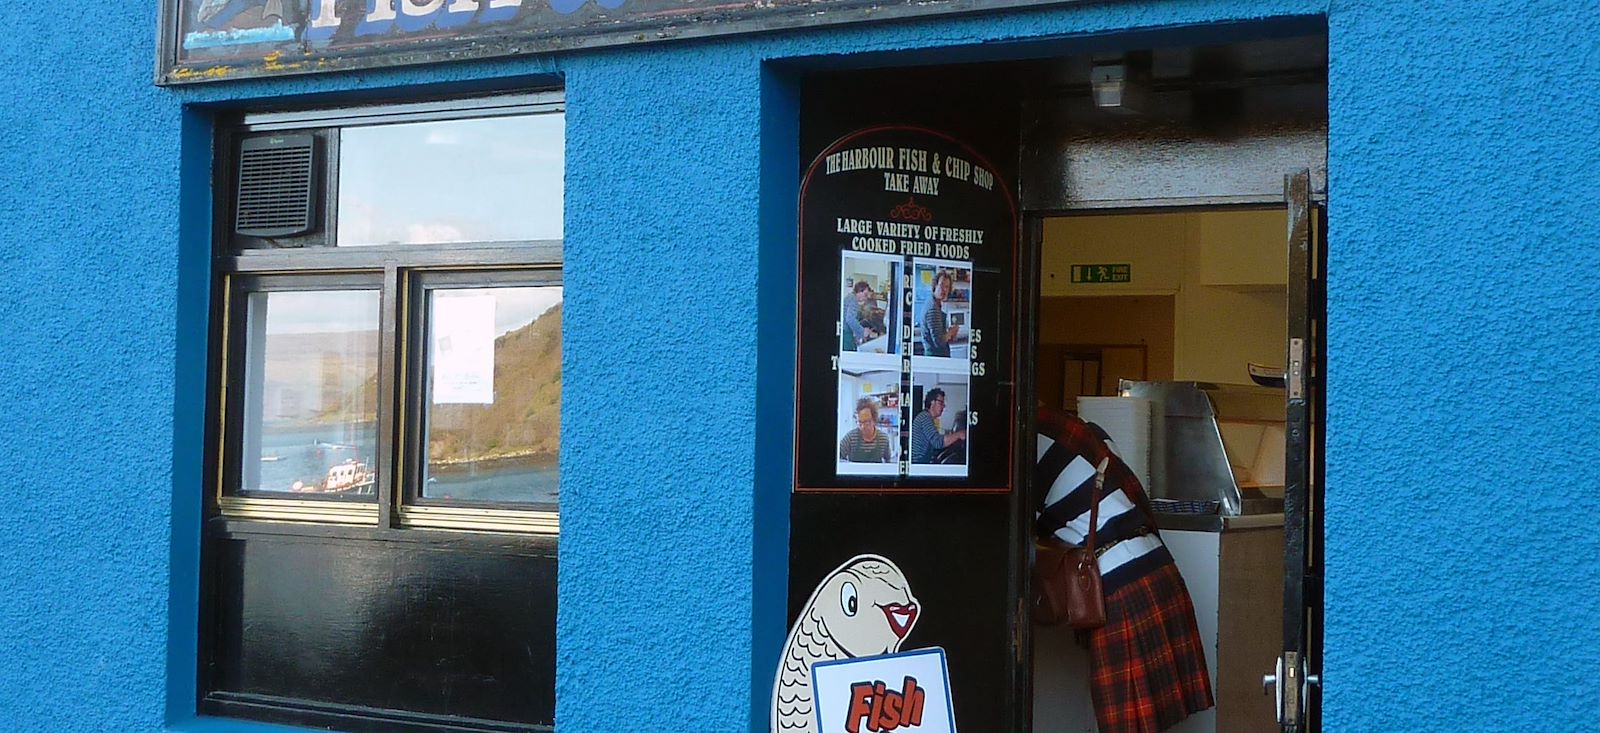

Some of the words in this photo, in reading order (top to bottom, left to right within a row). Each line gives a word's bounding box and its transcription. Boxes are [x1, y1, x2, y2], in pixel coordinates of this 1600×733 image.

[826, 154, 841, 175] THE
[841, 146, 894, 172] HARBOUR
[898, 148, 927, 173] FISH
[932, 152, 941, 174] &
[945, 156, 971, 181] CHIP
[973, 167, 994, 191] SHOP
[884, 172, 910, 193] TAKE
[912, 177, 940, 196] AWAY
[836, 217, 873, 235] LARGE
[876, 221, 921, 240] VARIETY
[924, 224, 939, 241] OF
[939, 226, 984, 244] FRESHLY
[851, 236, 897, 254] COOKED
[900, 240, 932, 257] FRIED
[935, 244, 970, 260] FOODS
[845, 676, 926, 733] Fish
